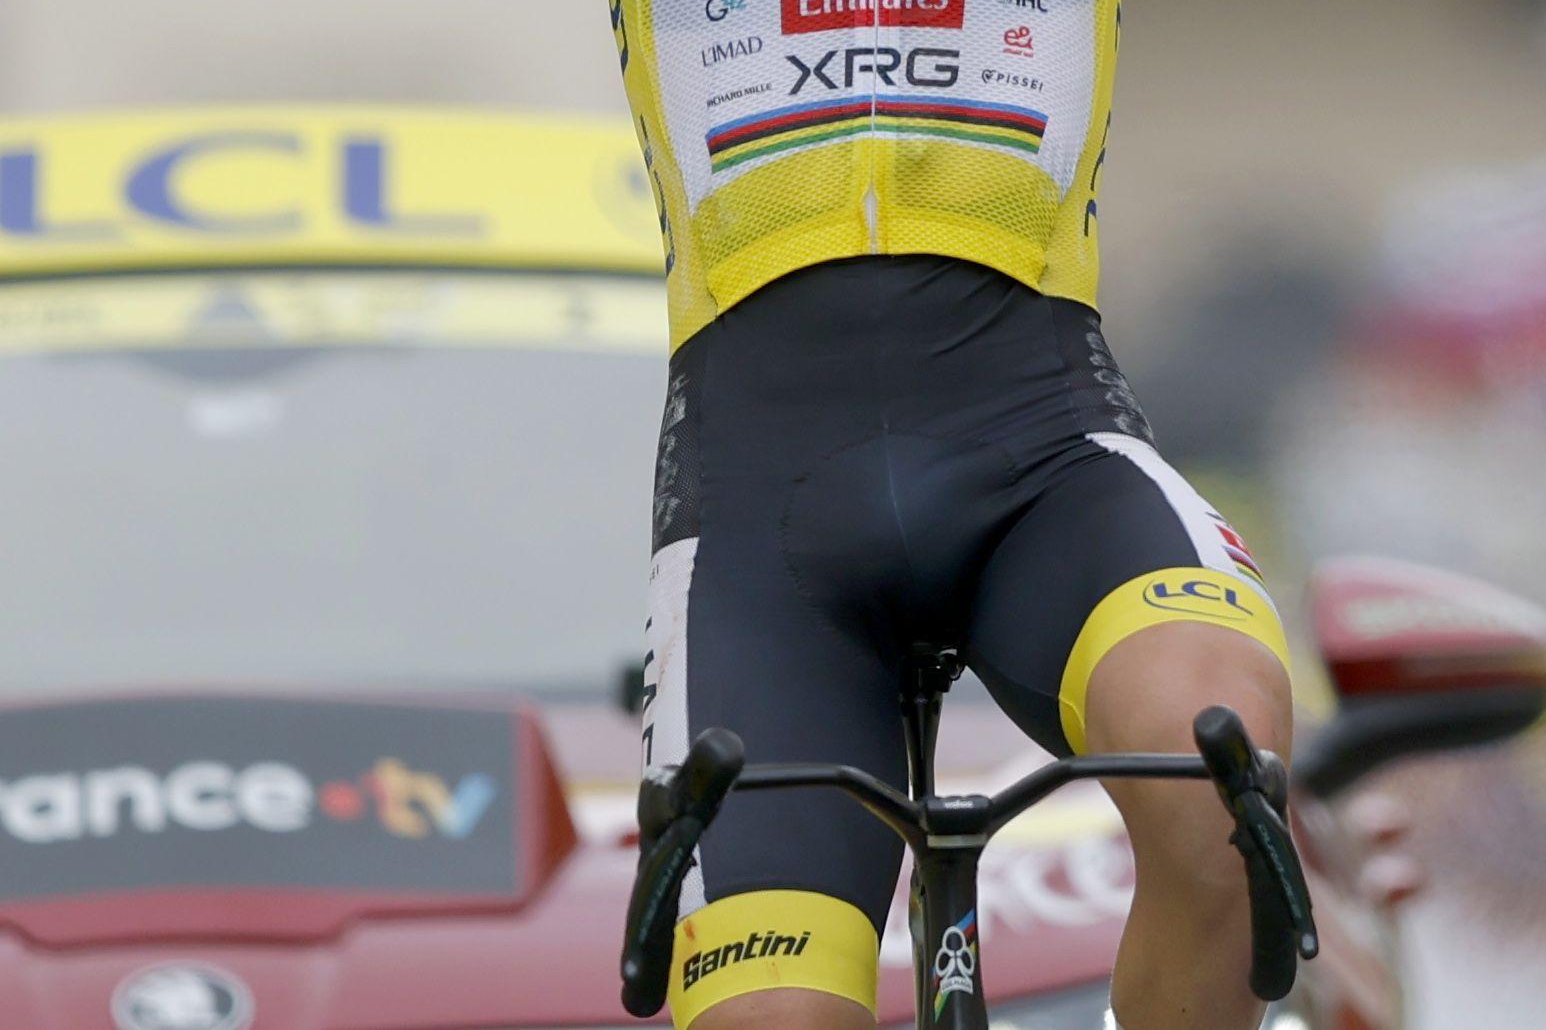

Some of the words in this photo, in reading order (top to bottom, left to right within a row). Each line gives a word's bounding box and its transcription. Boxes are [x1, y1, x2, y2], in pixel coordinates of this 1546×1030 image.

[783, 47, 961, 96] XRG
[996, 72, 1044, 92] PISSEI
[0, 128, 488, 238] LCL
[1152, 580, 1254, 616] LCL
[2, 760, 314, 842] ance
[682, 929, 812, 992] Santini
